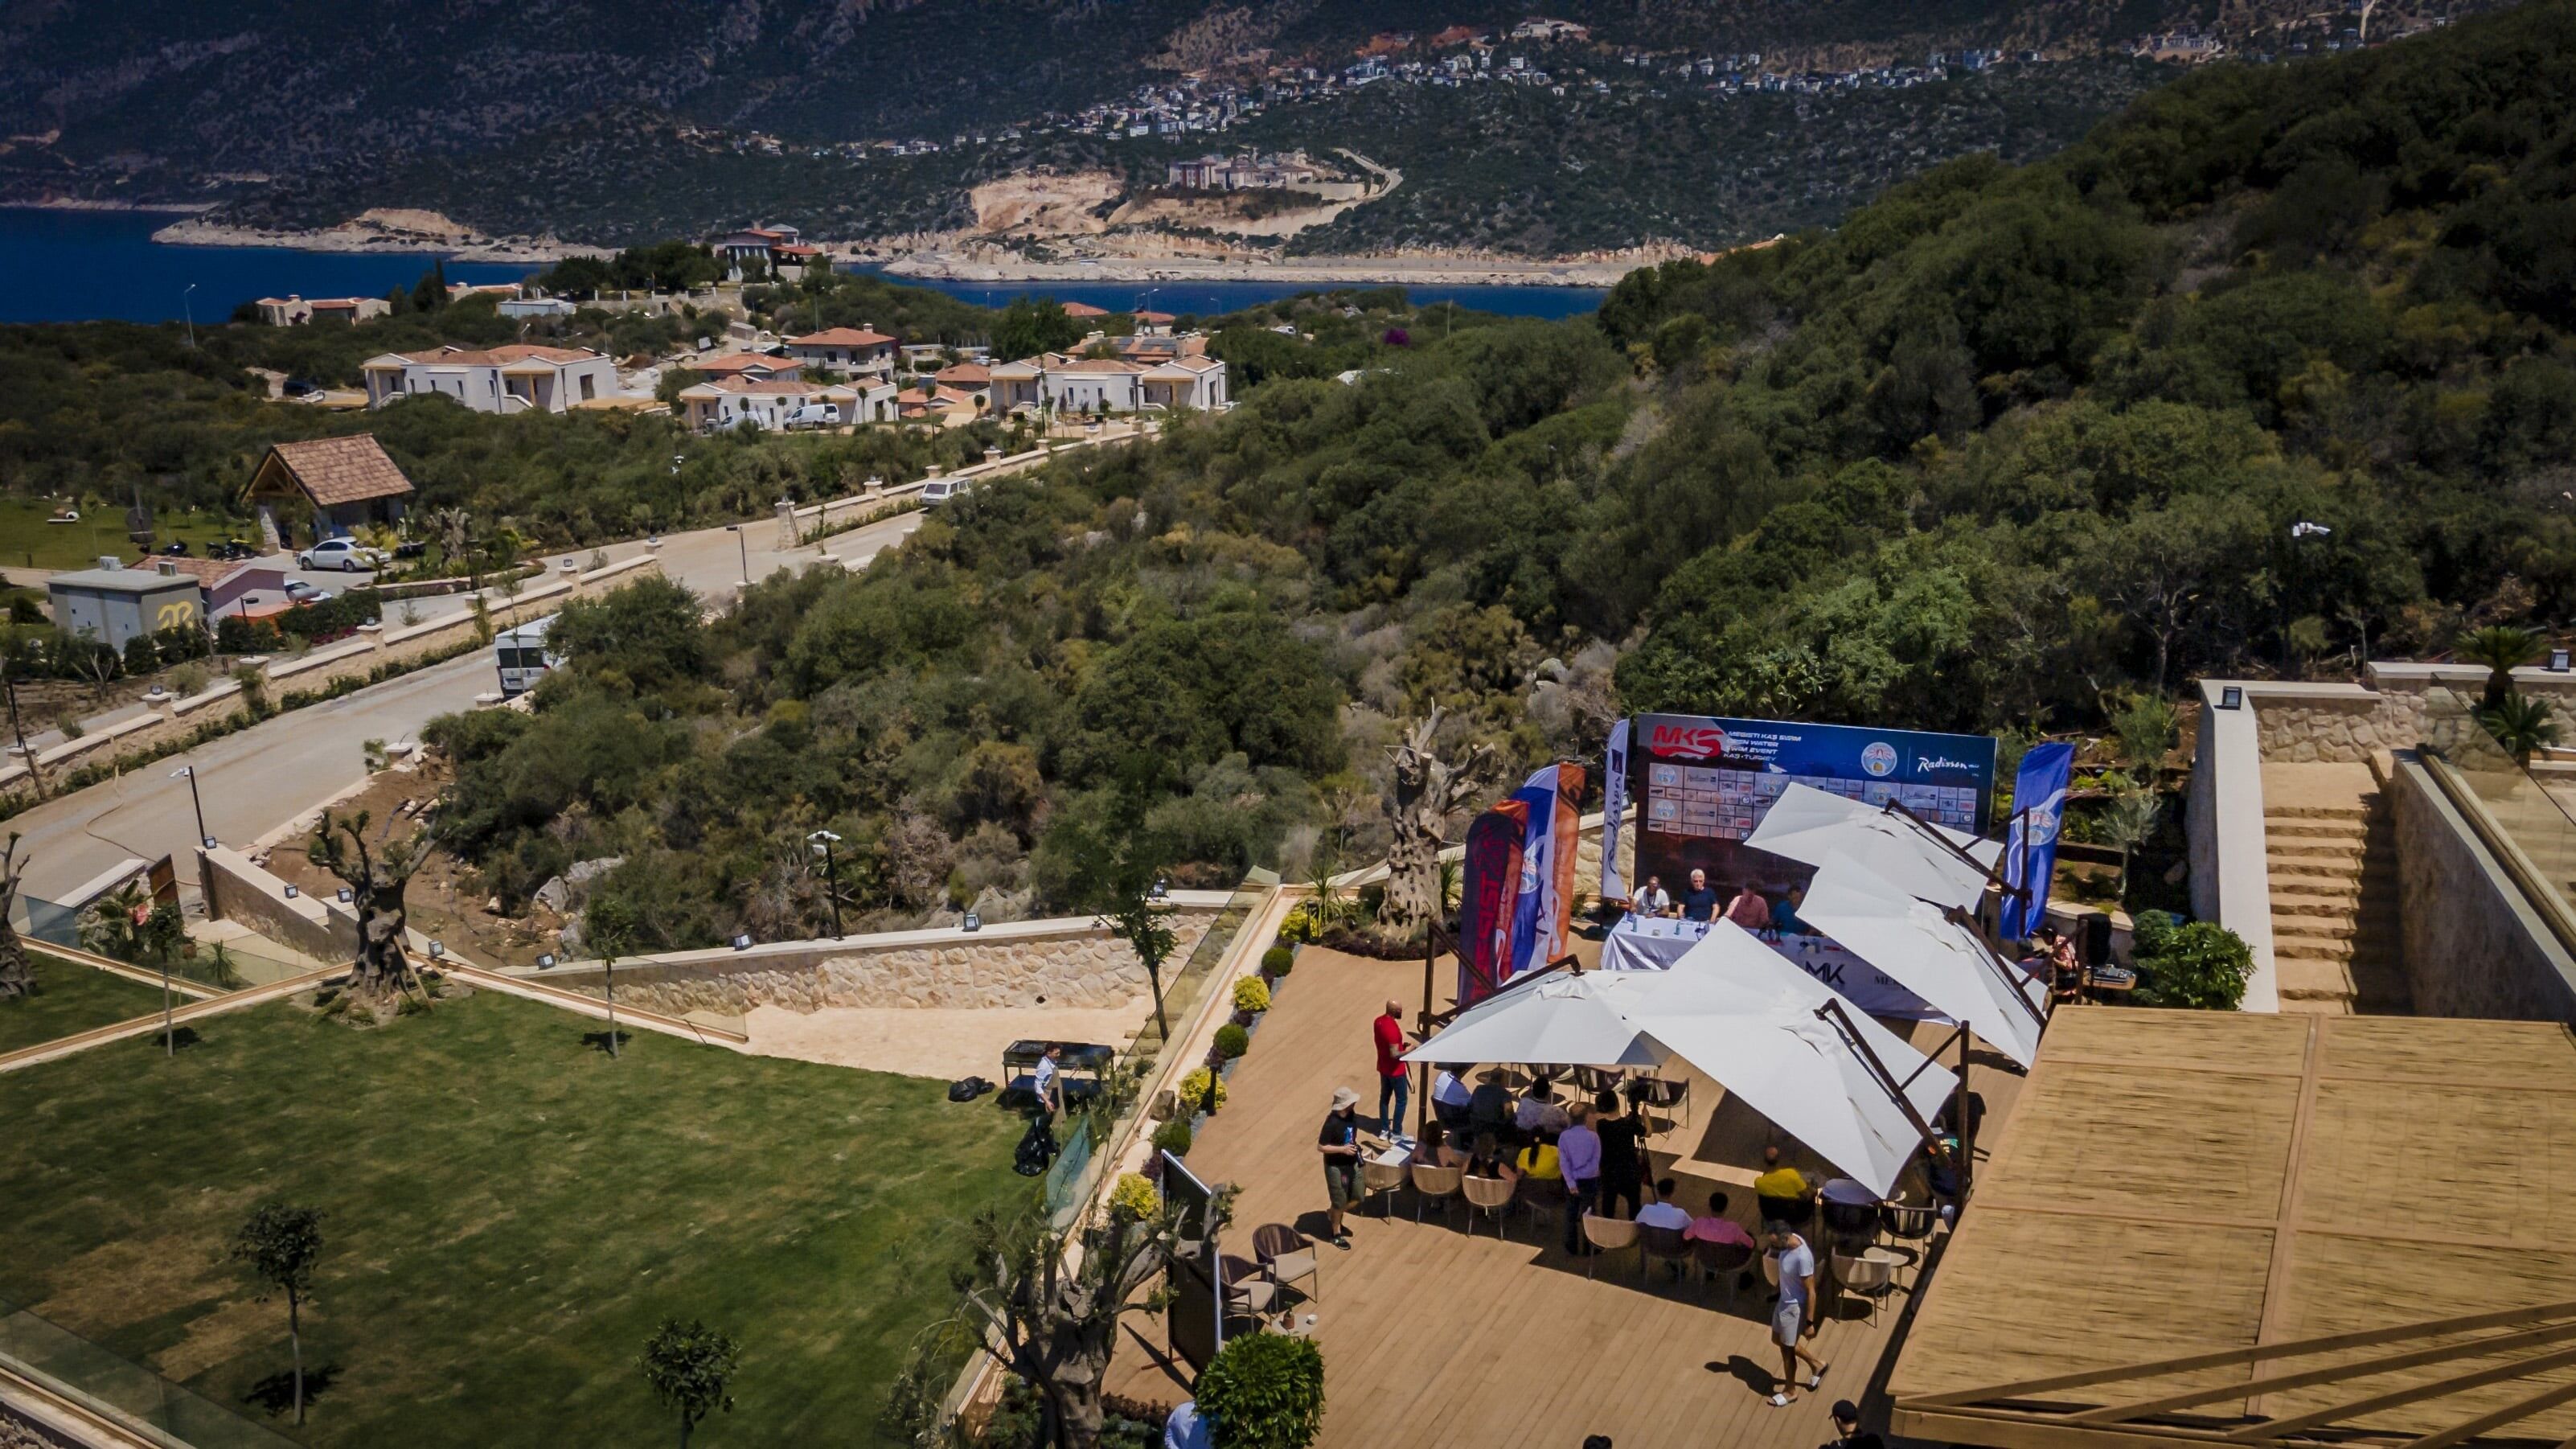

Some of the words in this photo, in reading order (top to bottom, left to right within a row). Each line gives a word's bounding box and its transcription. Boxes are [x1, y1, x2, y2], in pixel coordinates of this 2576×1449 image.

[1652, 724, 1724, 757] MKS
[1918, 756, 1968, 773] Radisson
[1805, 960, 1846, 985] MK
